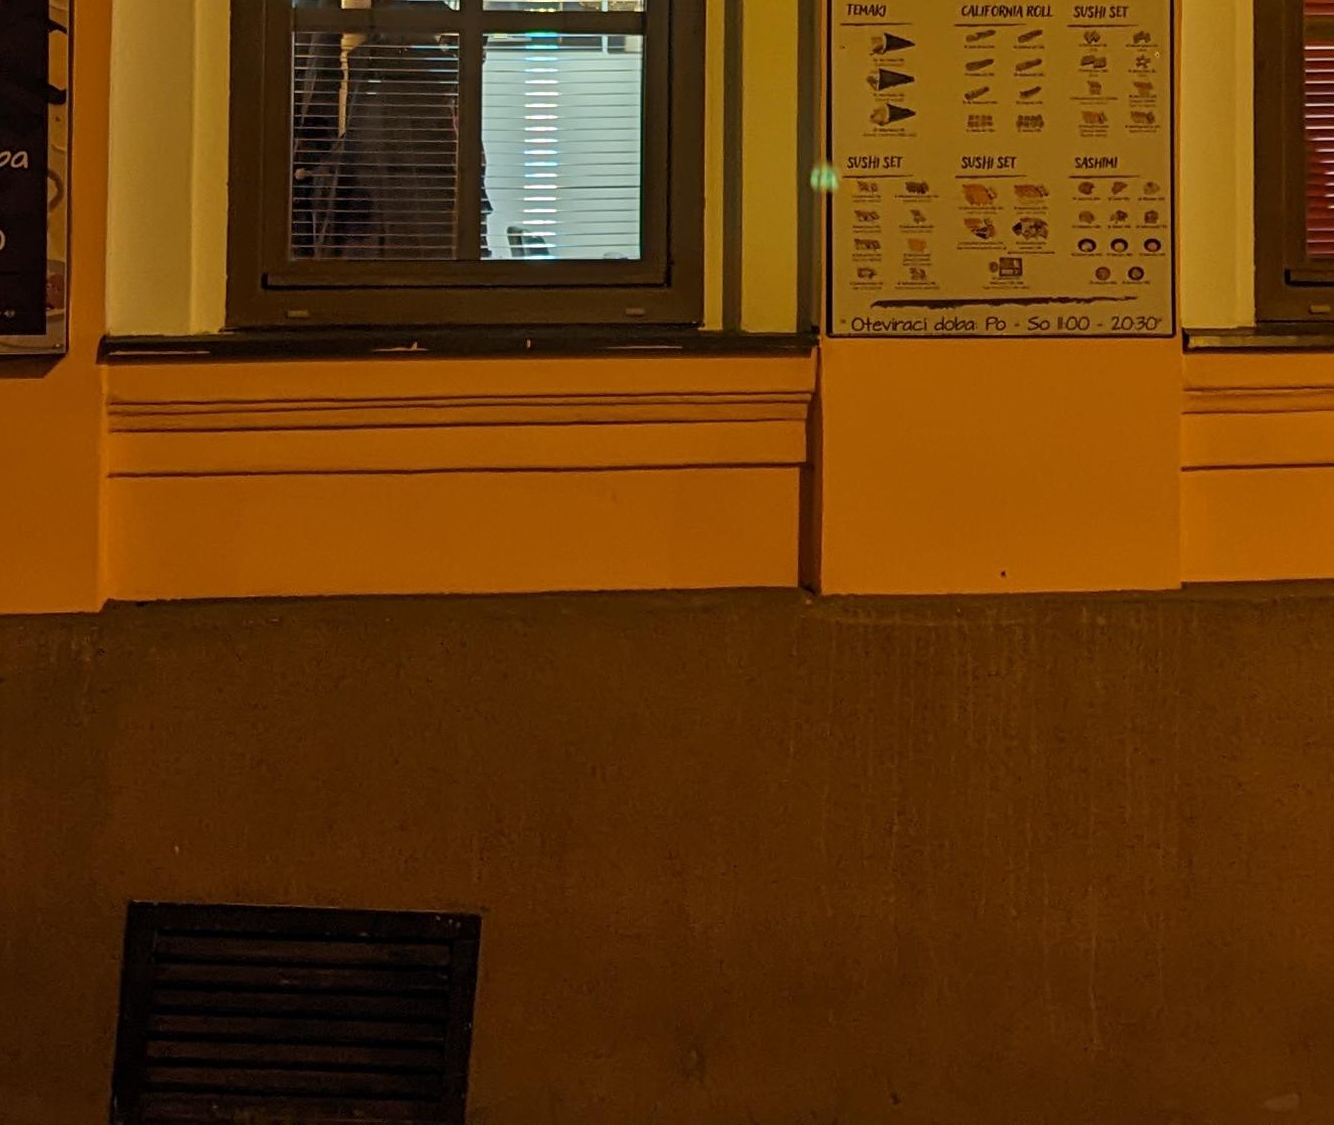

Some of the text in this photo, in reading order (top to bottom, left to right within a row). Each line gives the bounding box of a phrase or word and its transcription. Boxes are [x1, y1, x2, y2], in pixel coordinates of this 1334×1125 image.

[846, 3, 887, 18] TEMAKI
[961, 4, 1053, 19] CALIFORNIA ROLL
[1073, 5, 1129, 20] SUSHI SET
[846, 156, 903, 170] SUSHI SET
[961, 156, 1017, 170] SUSHI SET
[1074, 156, 1118, 169] SASHIMI
[851, 317, 927, 332] Oteviraci
[986, 316, 1007, 331] Po
[1027, 316, 1051, 331] So
